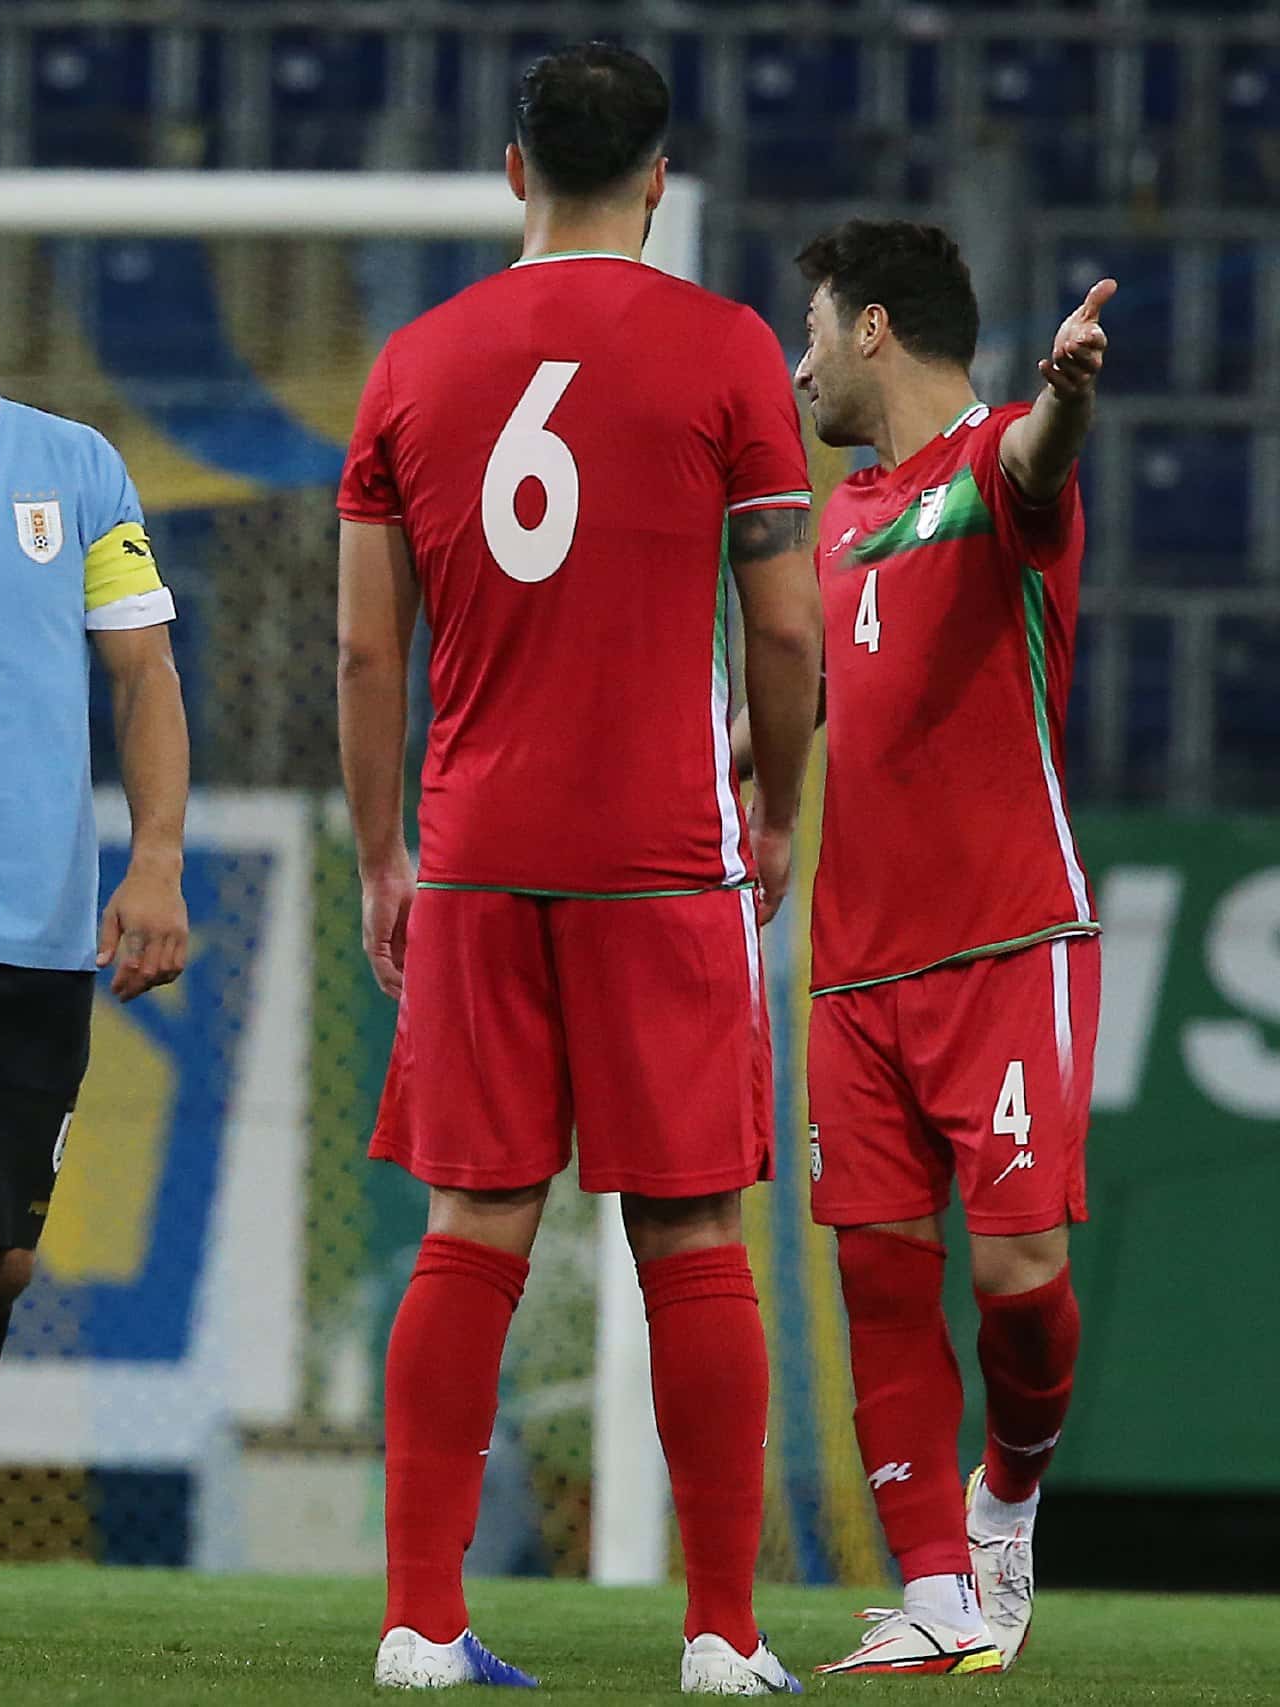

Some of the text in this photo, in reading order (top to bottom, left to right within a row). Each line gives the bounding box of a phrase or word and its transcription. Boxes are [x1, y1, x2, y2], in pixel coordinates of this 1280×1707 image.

[481, 360, 581, 583] 6
[854, 569, 881, 653] 4
[993, 1060, 1032, 1145] 4
